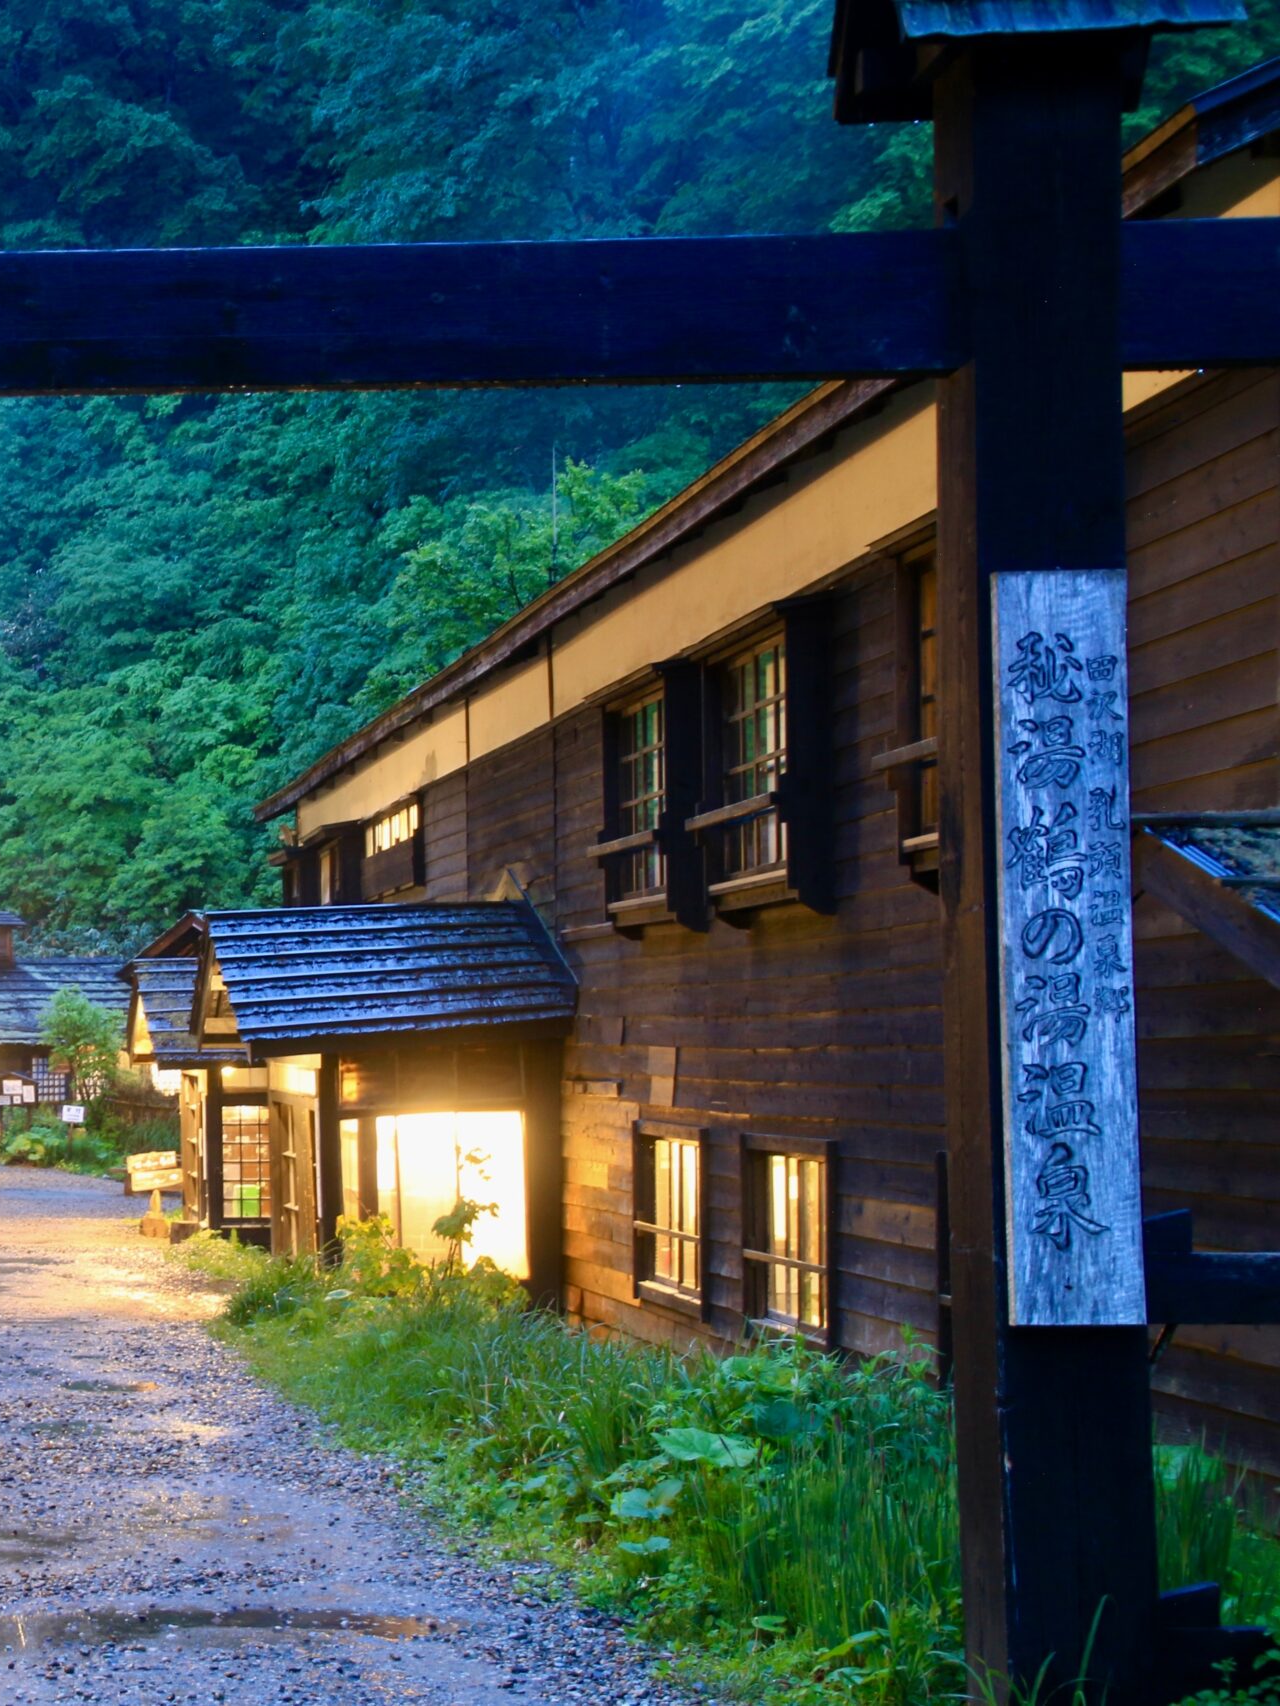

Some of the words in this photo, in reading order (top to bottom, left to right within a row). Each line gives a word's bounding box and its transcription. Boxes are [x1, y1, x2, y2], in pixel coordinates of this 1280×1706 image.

[1006, 631, 1111, 1252] 秘湯鶴の湯温泉
